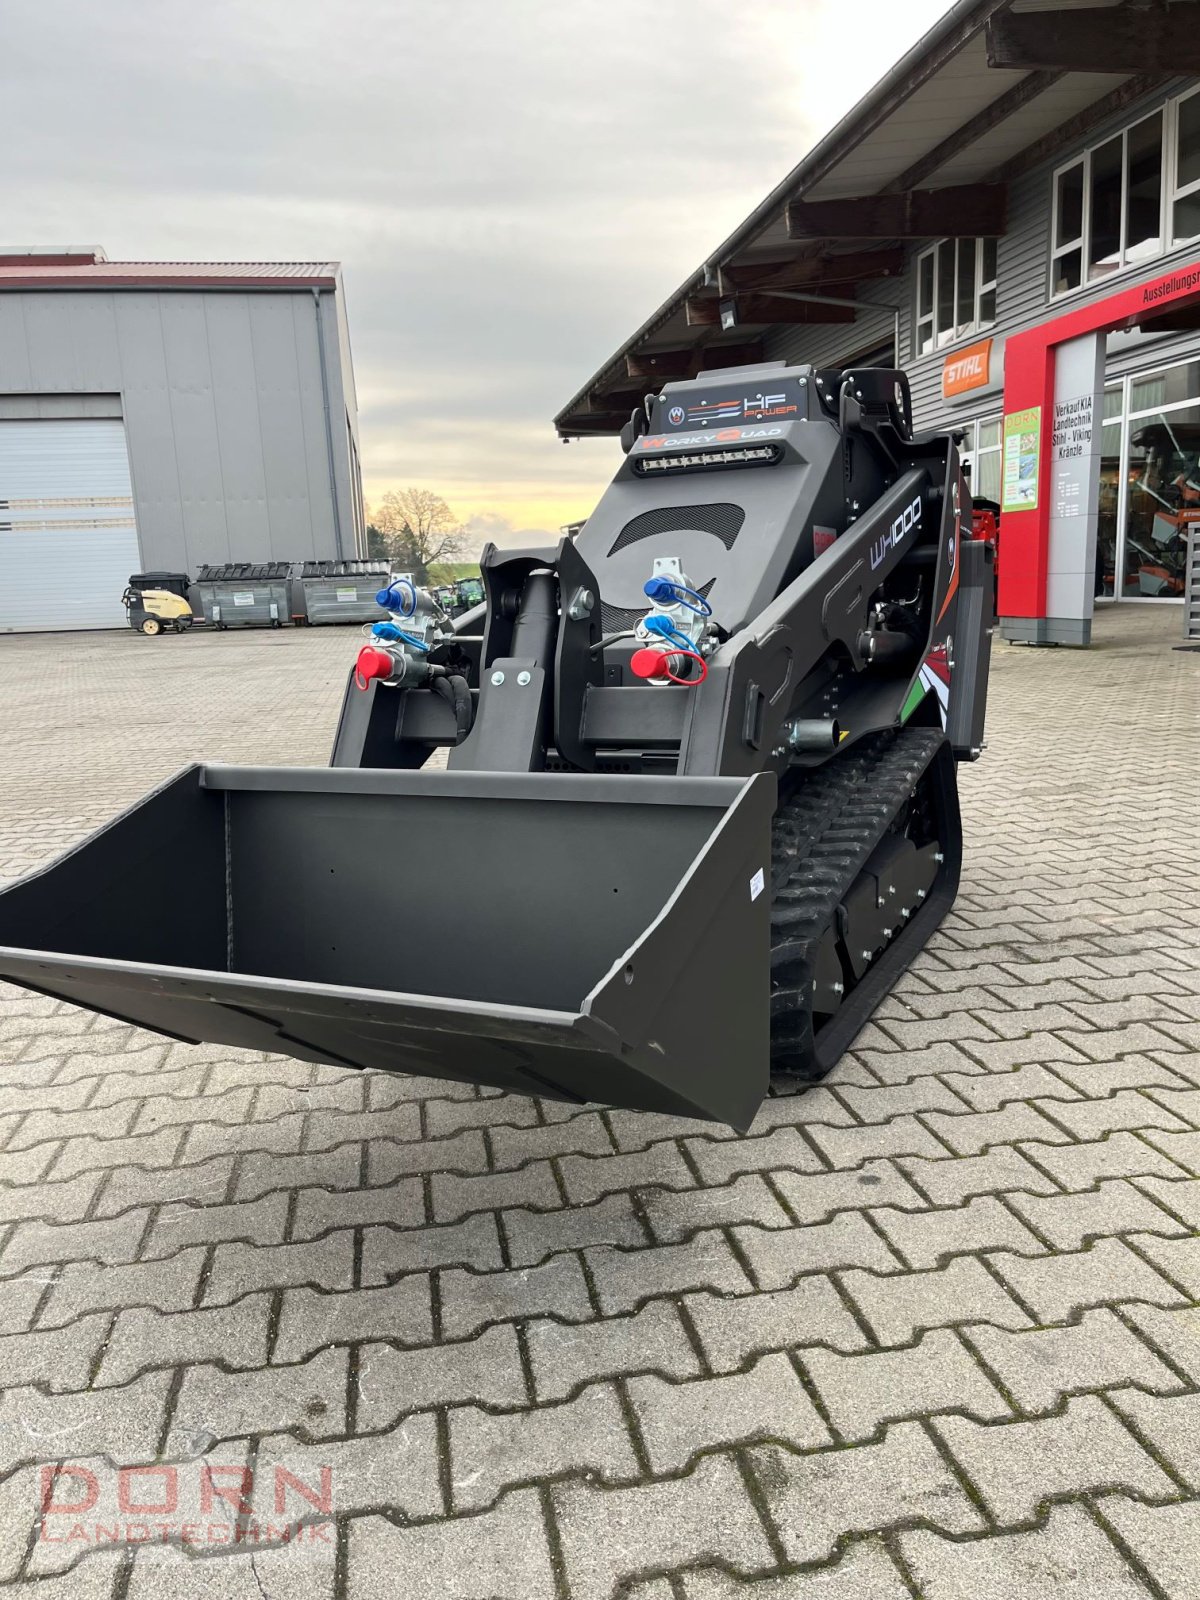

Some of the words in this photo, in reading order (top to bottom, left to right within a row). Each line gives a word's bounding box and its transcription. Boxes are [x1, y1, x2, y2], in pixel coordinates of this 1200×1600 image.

[947, 355, 982, 384] STIHL
[743, 394, 786, 411] HF
[744, 405, 797, 418] POWER
[1056, 400, 1080, 417] Verkauf
[1080, 396, 1092, 411] KIA
[1053, 411, 1092, 431] Landtechnik
[1052, 432, 1067, 447] Stihl
[1072, 428, 1092, 443] Viking
[1058, 444, 1083, 459] Kränzle
